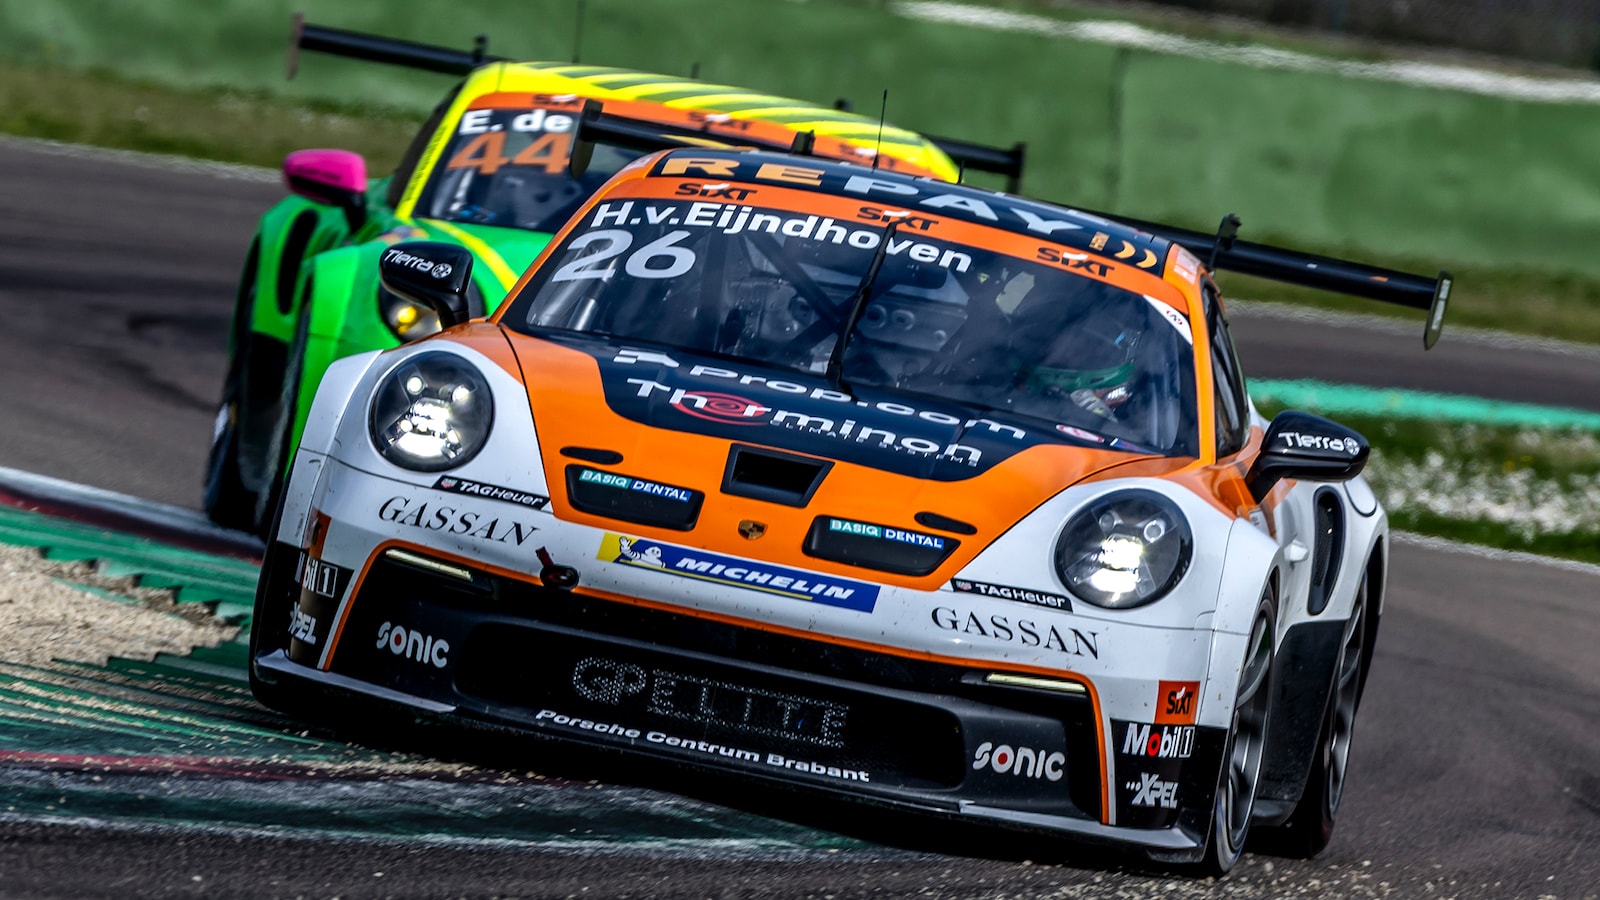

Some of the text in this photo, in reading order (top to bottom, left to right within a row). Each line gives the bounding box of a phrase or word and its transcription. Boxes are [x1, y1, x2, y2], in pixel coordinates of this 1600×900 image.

[460, 109, 574, 134] E. de
[446, 131, 573, 175] 44
[661, 157, 1084, 235] REPAY
[675, 182, 758, 201] SIXT
[589, 200, 973, 273] H.v.Eijndhoven
[856, 206, 939, 231] SIXT
[551, 229, 696, 283] 26
[1036, 246, 1115, 278] SIXT
[581, 469, 689, 501] BASIQ DENTAL
[377, 495, 540, 546] GASSAN
[831, 519, 944, 549] BASIQ DENTAL
[676, 556, 855, 600] MICHELIN
[931, 605, 1100, 661] GASSAN
[573, 656, 851, 748] GP ELITE
[1166, 685, 1194, 715] SIXT
[535, 708, 871, 783] Porsche Centrum Brabant
[1122, 722, 1181, 759] Mobil
[1131, 771, 1179, 810] XPEL
